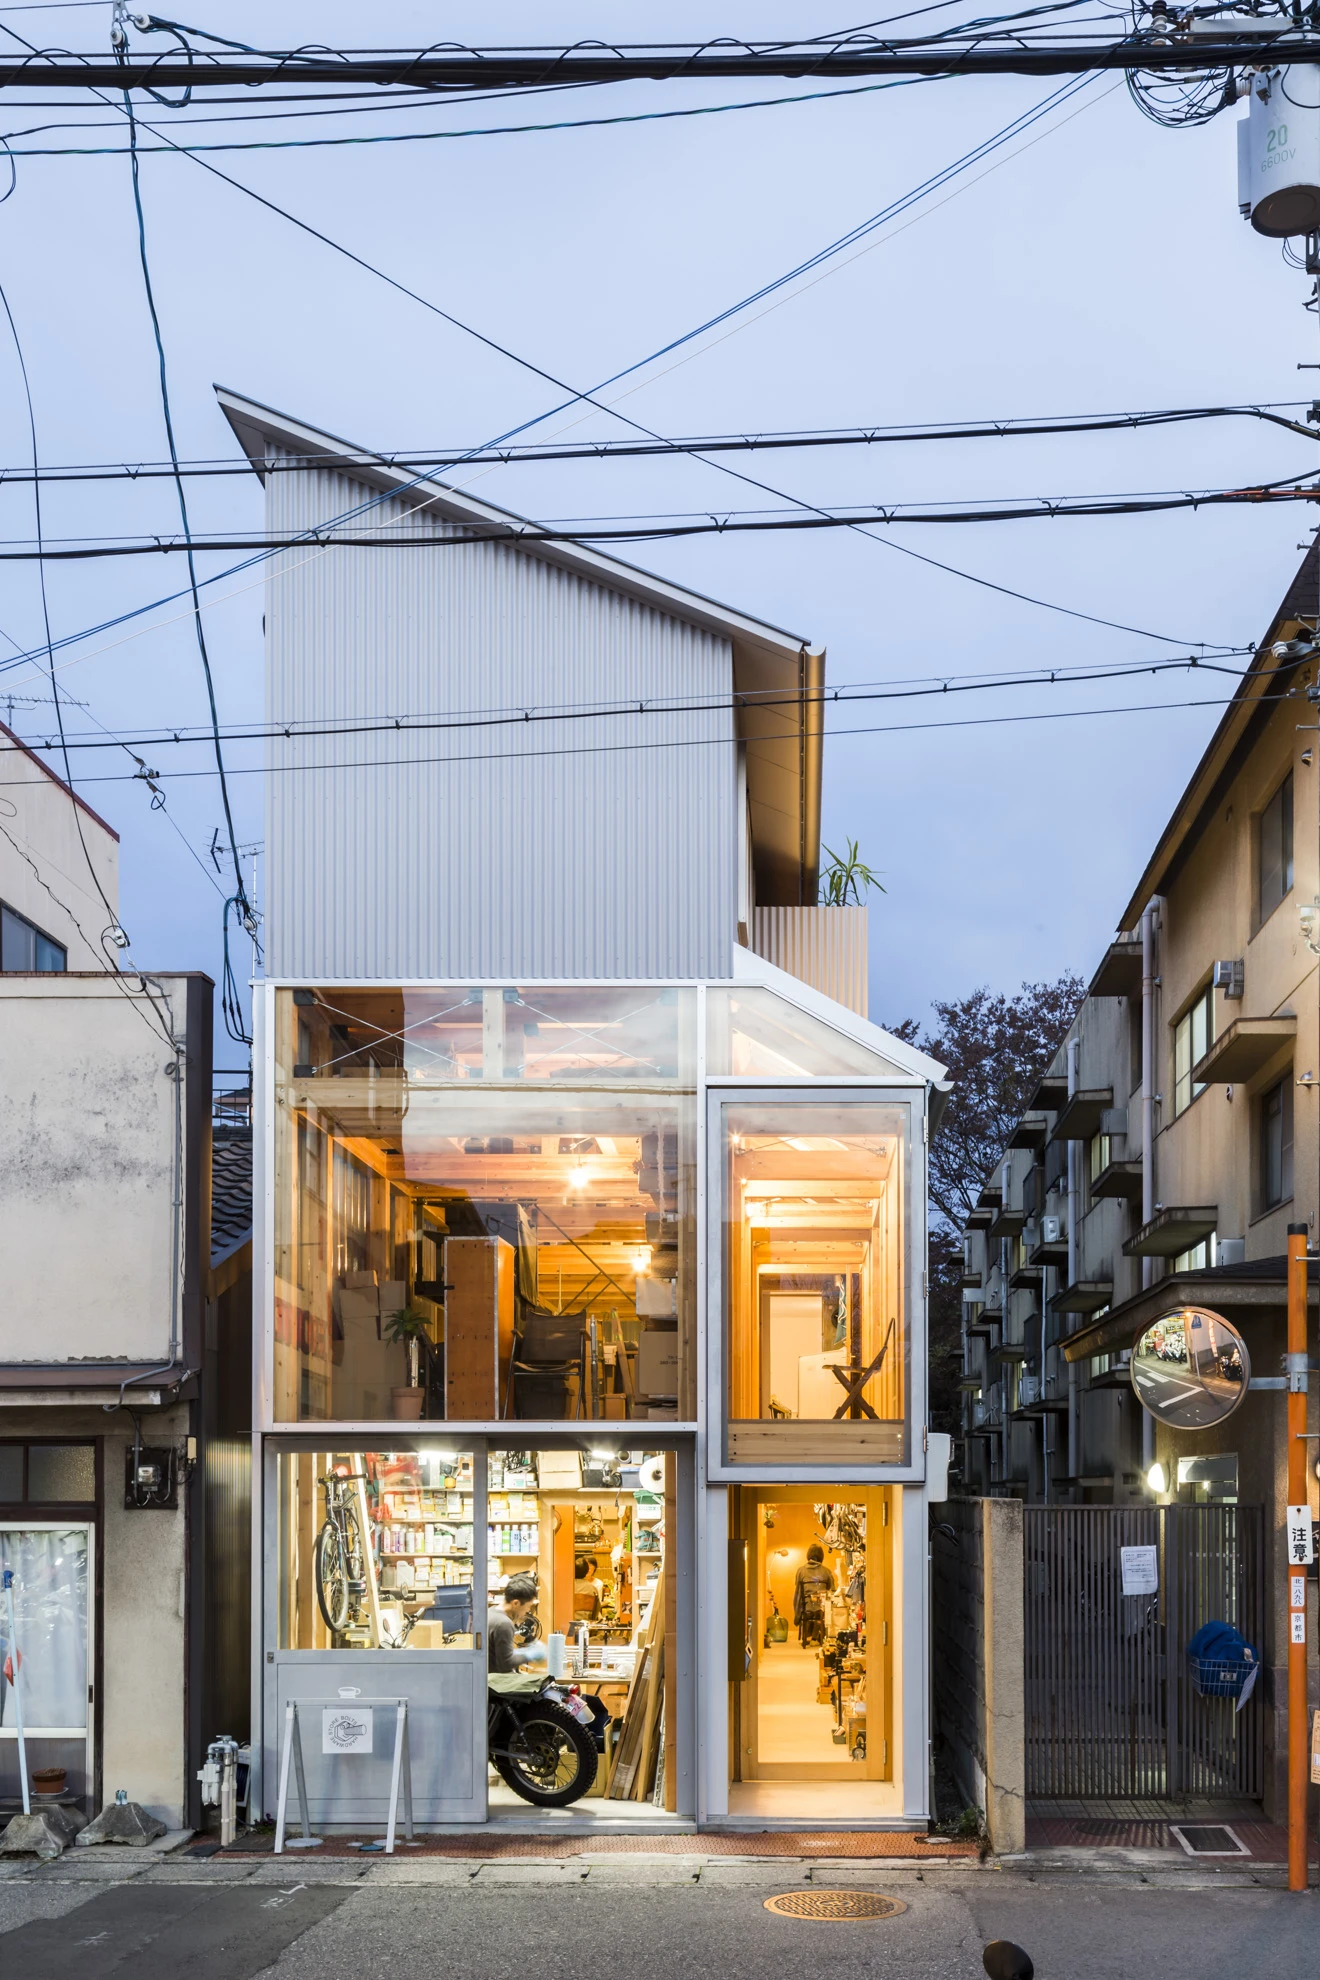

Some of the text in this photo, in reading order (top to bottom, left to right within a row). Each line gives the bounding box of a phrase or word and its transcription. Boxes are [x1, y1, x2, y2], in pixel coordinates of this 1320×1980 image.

[1267, 124, 1288, 153] 20
[1261, 147, 1297, 173] 6600V
[1292, 1527, 1308, 1559] 注意
[1294, 1614, 1303, 1642] 京都市
[328, 1715, 359, 1748] HARDWARE STORE BOLTS
